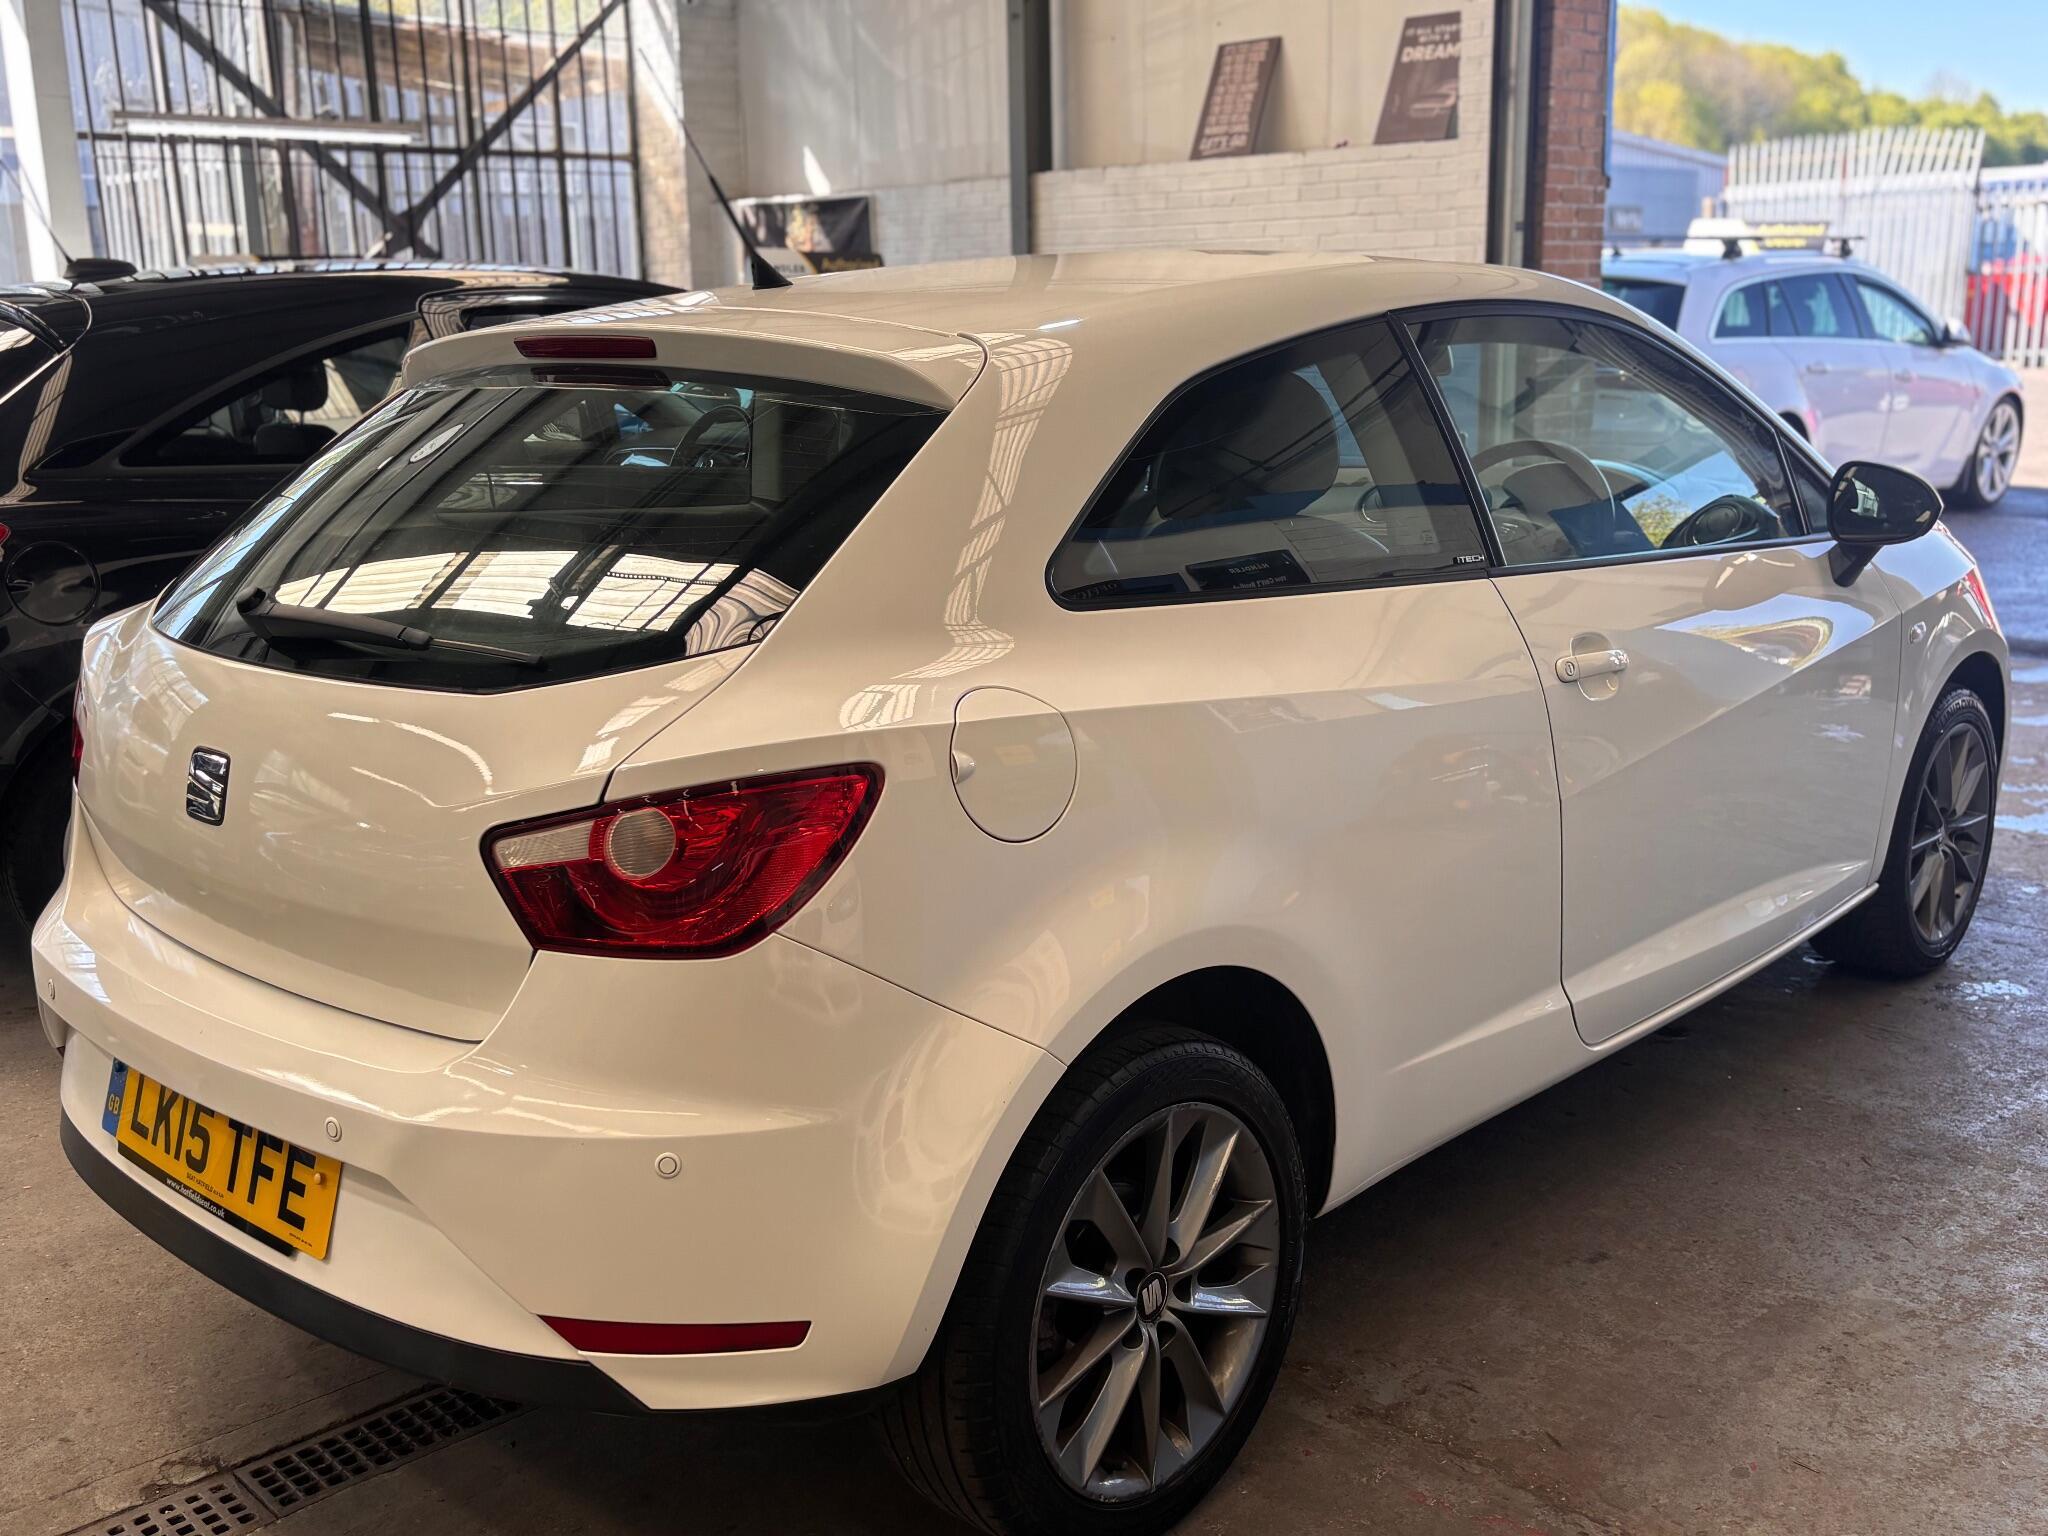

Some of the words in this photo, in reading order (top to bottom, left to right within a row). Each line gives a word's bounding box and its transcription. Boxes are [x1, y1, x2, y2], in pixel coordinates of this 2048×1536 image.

[108, 1094, 120, 1115] GB
[131, 1074, 215, 1174] LK15
[227, 1117, 317, 1231] TFE
